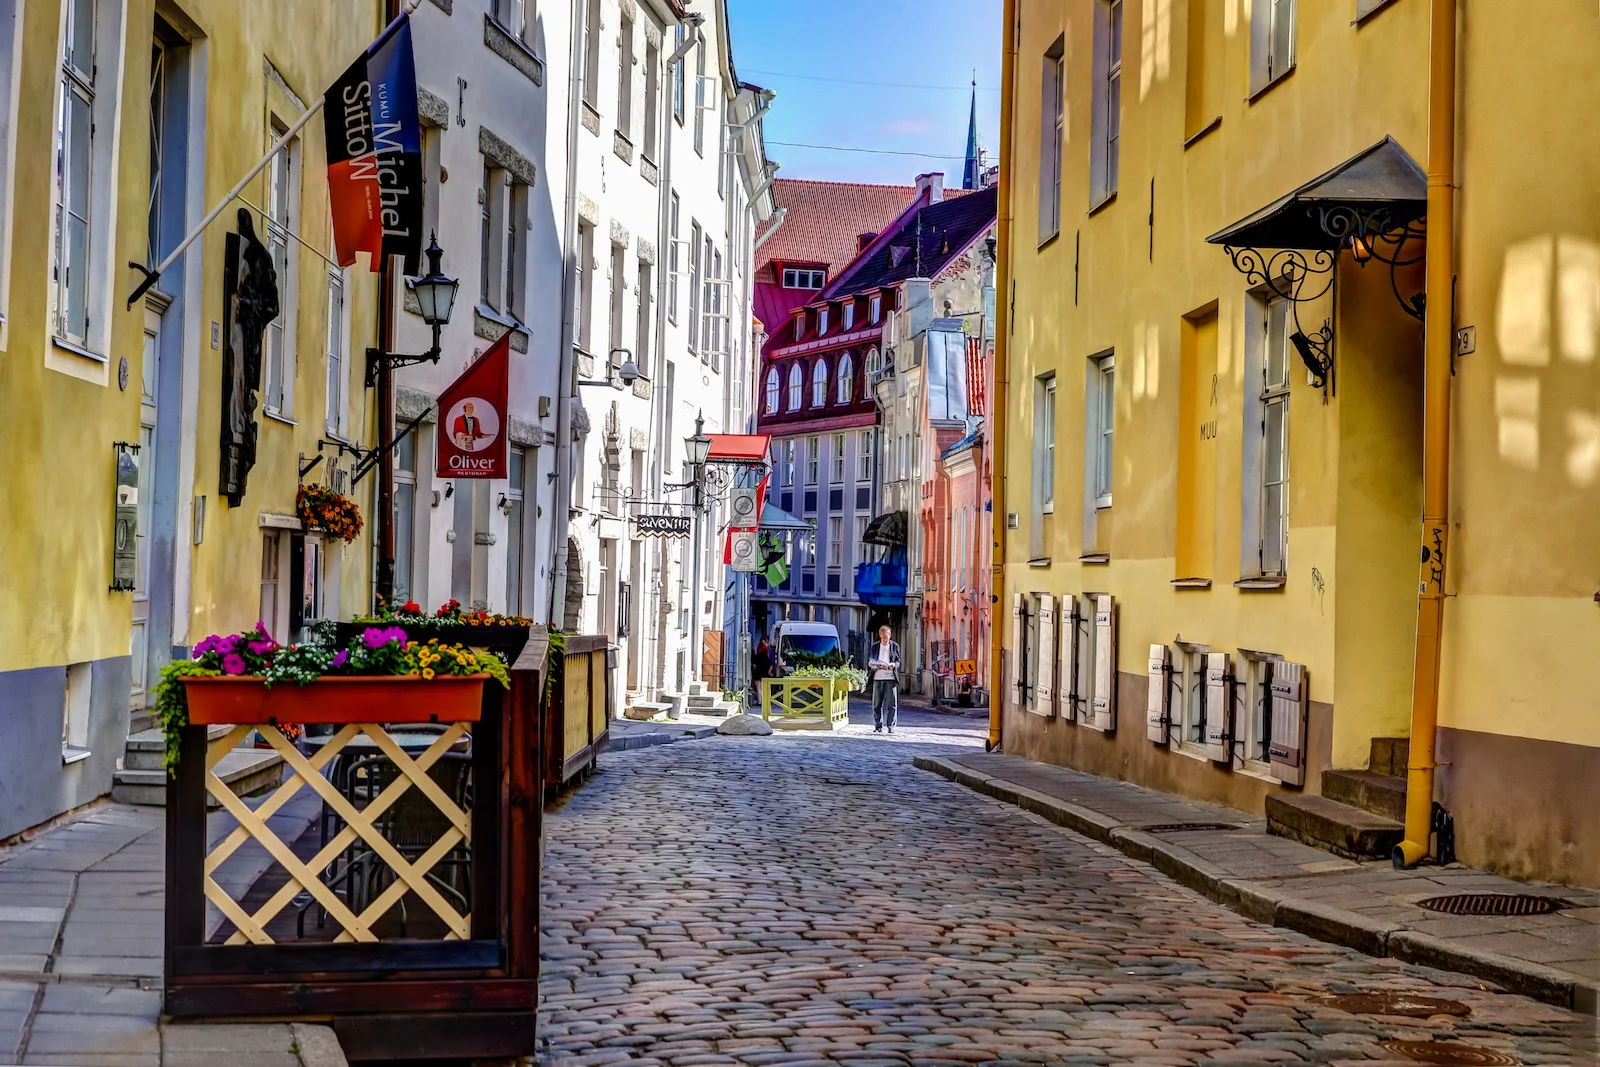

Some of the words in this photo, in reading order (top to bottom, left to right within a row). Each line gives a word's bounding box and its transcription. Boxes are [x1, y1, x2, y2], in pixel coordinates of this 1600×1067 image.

[378, 83, 389, 119] KUMU
[371, 120, 409, 237] Michel
[1463, 332, 1468, 349] 9
[449, 455, 495, 469] Oliver
